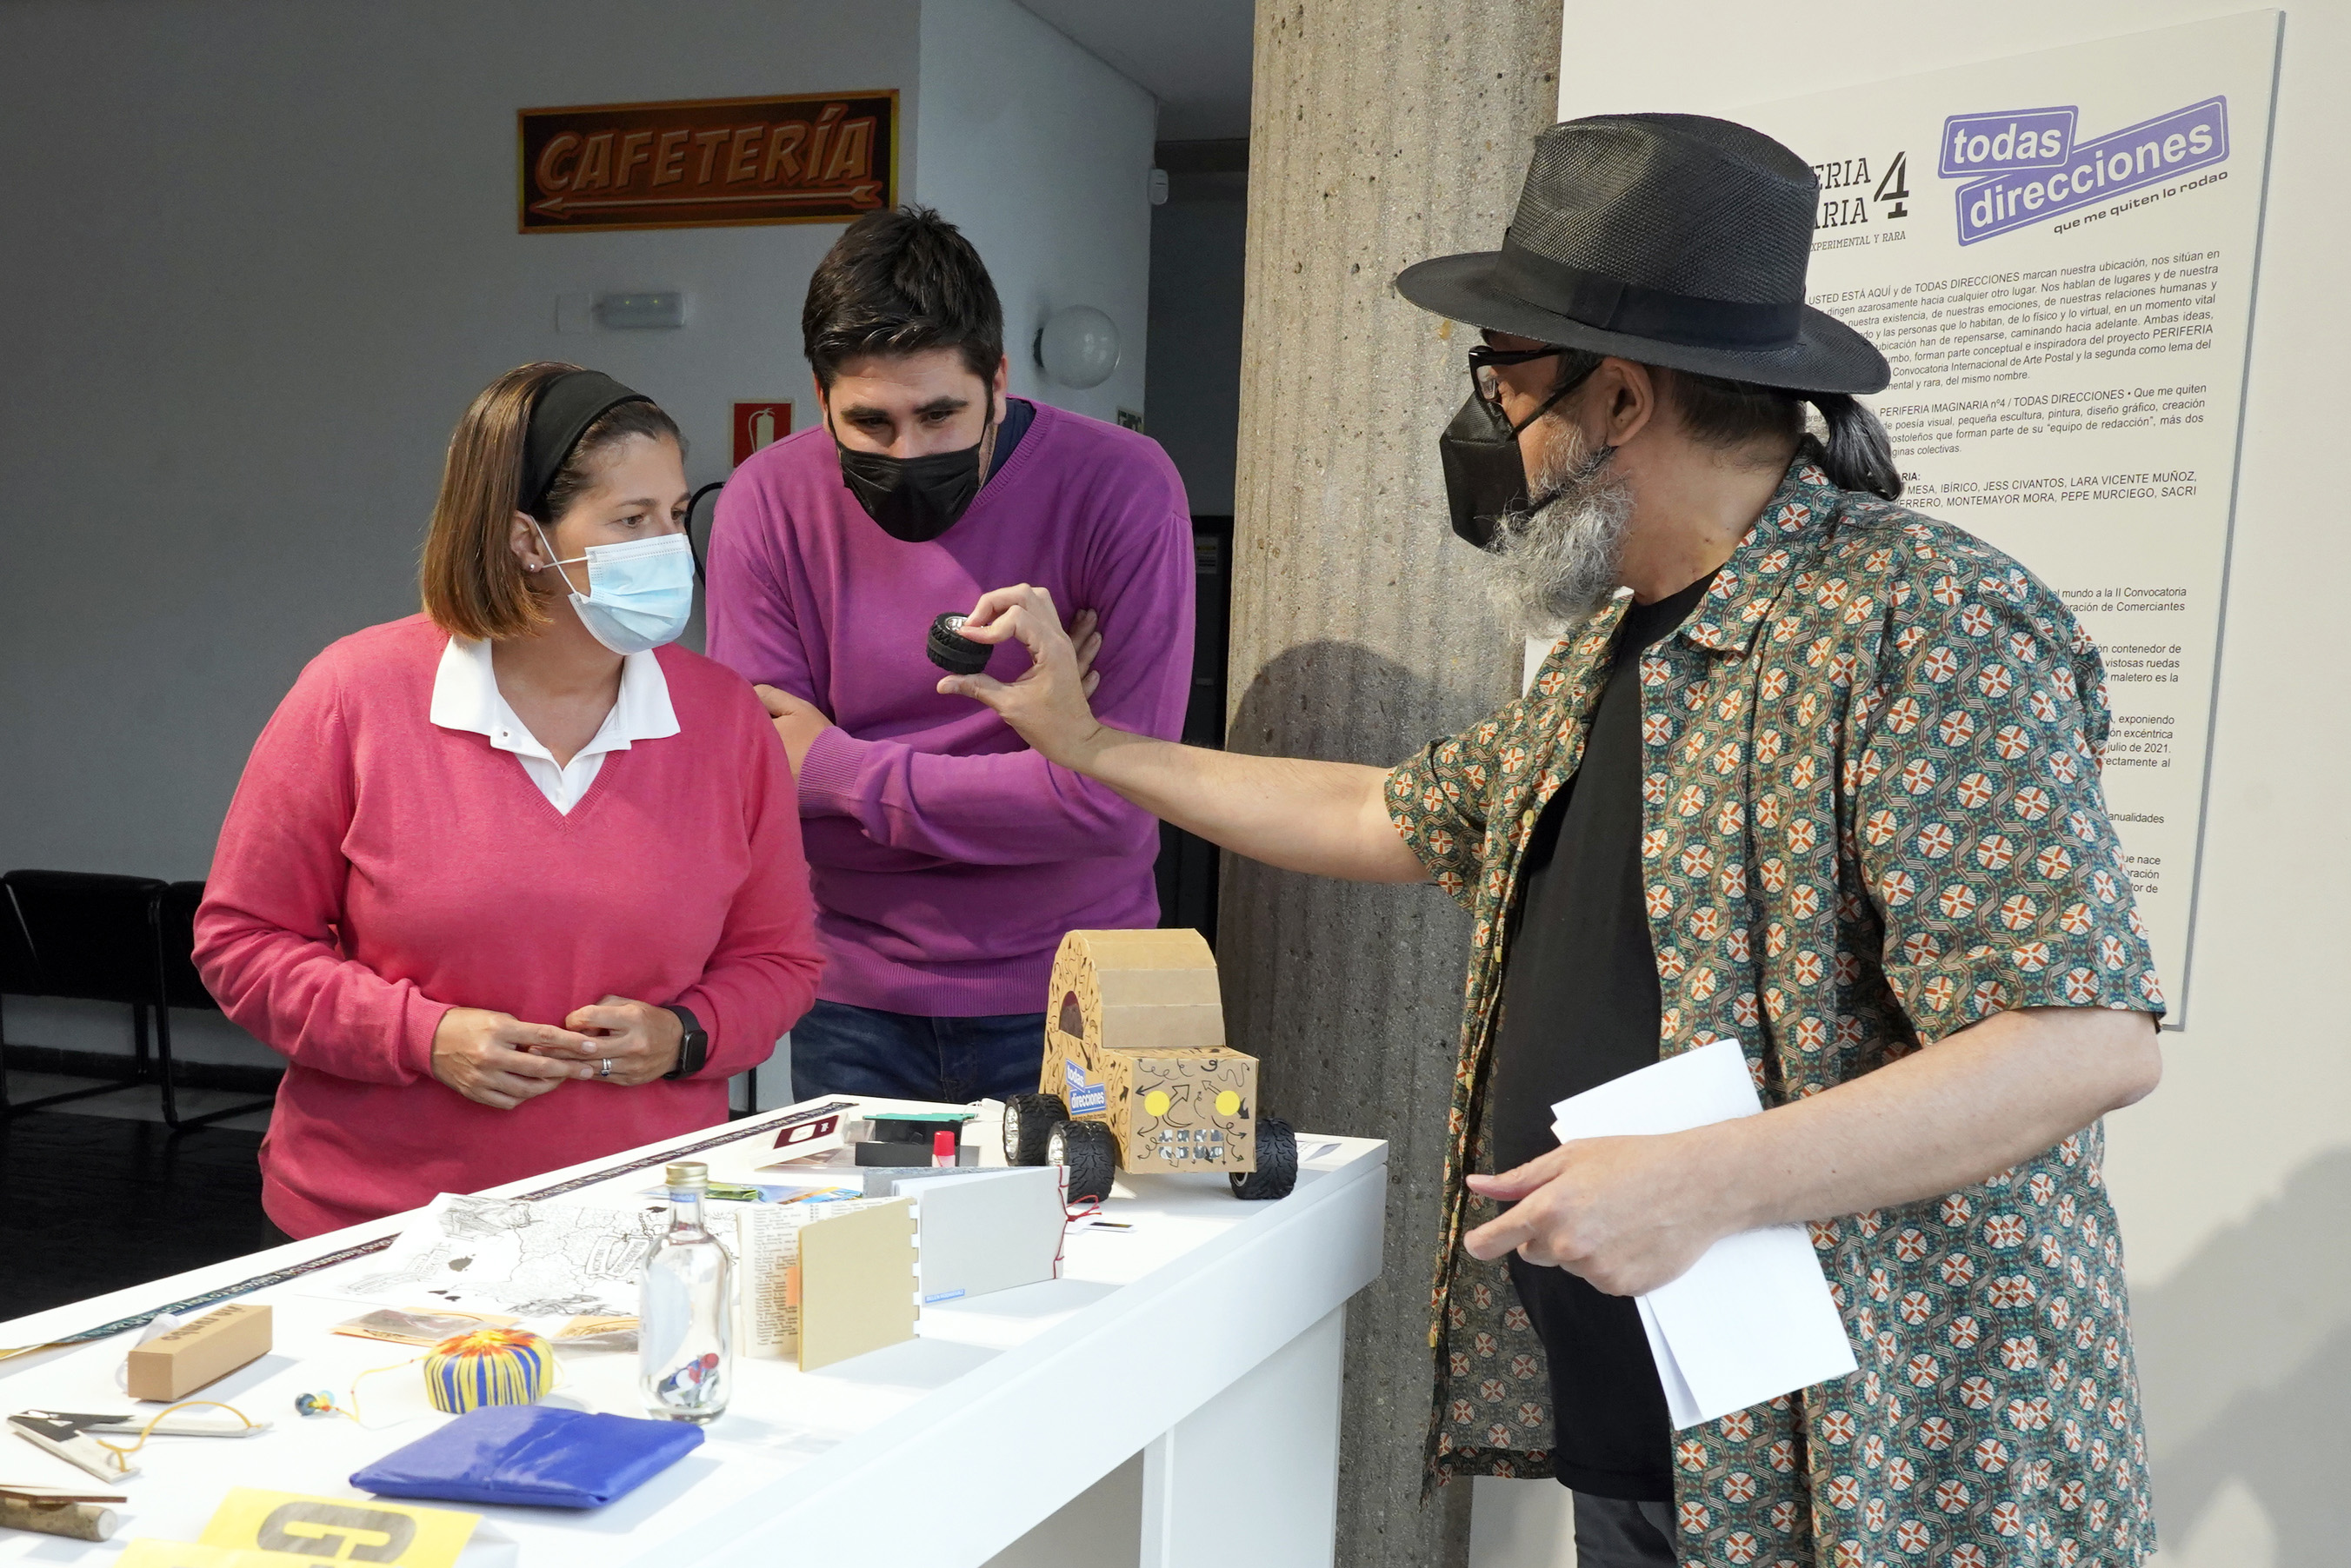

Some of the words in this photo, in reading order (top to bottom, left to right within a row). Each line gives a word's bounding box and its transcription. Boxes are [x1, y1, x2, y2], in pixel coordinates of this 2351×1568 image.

[538, 106, 871, 192] CAFETERÍA
[1954, 123, 2061, 164] todas
[1810, 157, 1871, 189] ERIA
[1874, 151, 1909, 219] 4
[1970, 123, 2213, 229] direcciones
[1815, 197, 1868, 229] RIA
[2054, 219, 2081, 235] que
[2084, 210, 2107, 224] me
[2110, 193, 2160, 216] quiten
[2163, 188, 2176, 198] lo
[2180, 171, 2228, 193] rodao
[1810, 236, 1870, 252] XPERIMENTAL
[1874, 234, 1880, 243] Y
[1882, 230, 1906, 243] RARA
[1809, 293, 1839, 305] USTED
[1842, 288, 1865, 301] ESTÁ
[1867, 284, 1891, 298] AQUÍ
[1915, 280, 1948, 292] TODAS
[1950, 271, 2020, 289] DIRECCIONES
[2022, 269, 2057, 280] marcan
[2060, 264, 2095, 276] nuestra
[2151, 256, 2169, 265] nos
[2172, 251, 2203, 263] sitúan
[2207, 250, 2220, 259] en
[1857, 298, 1918, 313] azarosamente
[1921, 295, 1944, 305] hacia
[1947, 290, 1988, 302] cualquier
[1991, 289, 2009, 298] otro
[2041, 282, 2060, 292] Nos
[2062, 278, 2095, 289] hablan
[2114, 273, 2151, 286] lugares
[2179, 264, 2218, 277] nuestra
[1848, 316, 1879, 328] nuestra
[1946, 305, 1984, 316] nuestras
[2060, 293, 2101, 304] nuestras
[2105, 287, 2155, 300] relaciones
[2159, 282, 2207, 294] humanas
[1882, 328, 1895, 336] las
[1897, 324, 1937, 337] personas
[1940, 322, 1956, 333] que
[2033, 311, 2057, 322] físico
[2114, 304, 2127, 313] en
[2129, 303, 2141, 312] un
[2145, 296, 2192, 310] momento
[2194, 293, 2215, 305] vital
[1915, 351, 1945, 361] forman
[1947, 348, 1970, 360] parte
[1973, 342, 2022, 355] conceptual
[2034, 337, 2087, 351] inspiradora
[2089, 334, 2104, 344] del
[2106, 330, 2150, 345] proyecto
[2152, 323, 2213, 339] PERIFERIA
[1920, 337, 1935, 347] han
[2010, 324, 2062, 338] caminando
[2065, 322, 2091, 332] hacia
[2143, 313, 2179, 325] Ambas
[1893, 363, 1948, 376] Convocatoria
[1951, 357, 2008, 371] Internacional
[2009, 356, 2021, 366] de
[2022, 355, 2042, 365] Arte
[2044, 351, 2074, 362] Postal
[2083, 349, 2092, 359] la
[2095, 346, 2136, 360] segunda
[2138, 345, 2166, 355] como
[2168, 342, 2193, 352] lema
[2195, 338, 2211, 349] del
[1945, 375, 1959, 385] del
[1961, 375, 1991, 384] mismo
[1879, 404, 1929, 416] PERIFERIA
[1931, 400, 1988, 413] IMAGINARIA
[1990, 398, 2005, 409] nº4
[2014, 395, 2048, 407] TODAS
[2051, 389, 2124, 404] DIRECCIONES
[2134, 387, 2155, 398] Que
[2157, 387, 2173, 395] me
[2175, 383, 2207, 396] quiten
[1895, 418, 1924, 431] poesía
[1957, 413, 1997, 427] pequeña
[2087, 404, 2119, 415] diseño
[2161, 398, 2205, 410] creación
[1889, 432, 1933, 443] ostoleños
[1935, 432, 1953, 442] que
[1955, 429, 1987, 438] forman
[1990, 427, 2014, 438] parte
[2016, 425, 2028, 435] de
[2047, 422, 2082, 434] “equipo
[2085, 420, 2098, 430] de
[2160, 414, 2181, 425] más
[2184, 413, 2203, 423] dos
[1946, 494, 2020, 506] MONTEMAYOR
[2061, 490, 2090, 501] PEPE
[2161, 485, 2196, 497] SACRI
[1983, 480, 2008, 491] JESS
[2070, 475, 2099, 487] LARA
[2101, 473, 2149, 485] VICENTE
[2061, 588, 2094, 598] mundo
[2104, 588, 2113, 597] la
[2115, 588, 2121, 597] II
[2123, 587, 2187, 597] Convocatoria
[2101, 601, 2113, 611] de
[2116, 601, 2185, 611] Comerciantes
[2105, 658, 2144, 668] vistosas
[2146, 658, 2180, 668] ruedas
[2111, 643, 2166, 654] contenedor
[2168, 643, 2181, 654] de
[2110, 672, 2153, 681] maletero
[2169, 672, 2178, 682] la
[2118, 714, 2175, 726] exponiendo
[2104, 756, 2157, 767] ectamente
[2161, 758, 2170, 767] al
[2106, 741, 2127, 754] julio
[2128, 742, 2141, 752] de
[2136, 856, 2161, 865] nace
